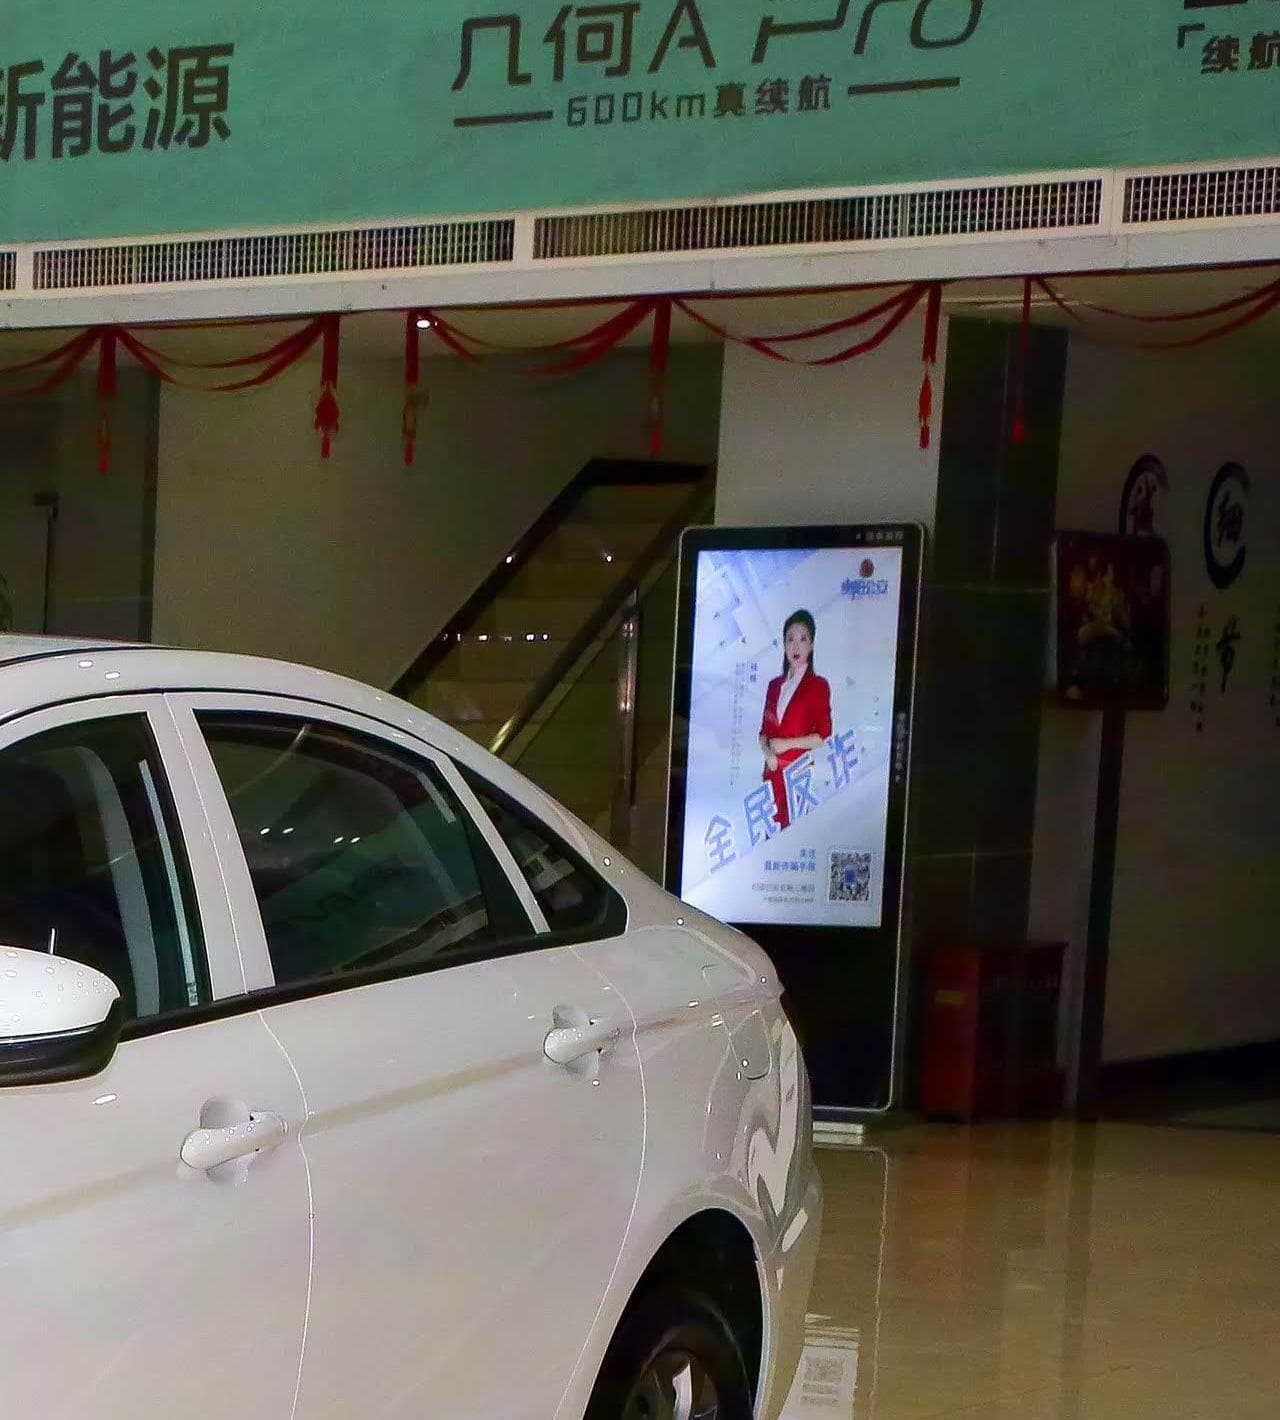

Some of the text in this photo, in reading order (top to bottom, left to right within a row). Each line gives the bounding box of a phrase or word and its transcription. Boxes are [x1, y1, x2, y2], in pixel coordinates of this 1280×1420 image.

[566, 74, 832, 127] 600km真续航
[703, 728, 861, 876] 全民反诈
